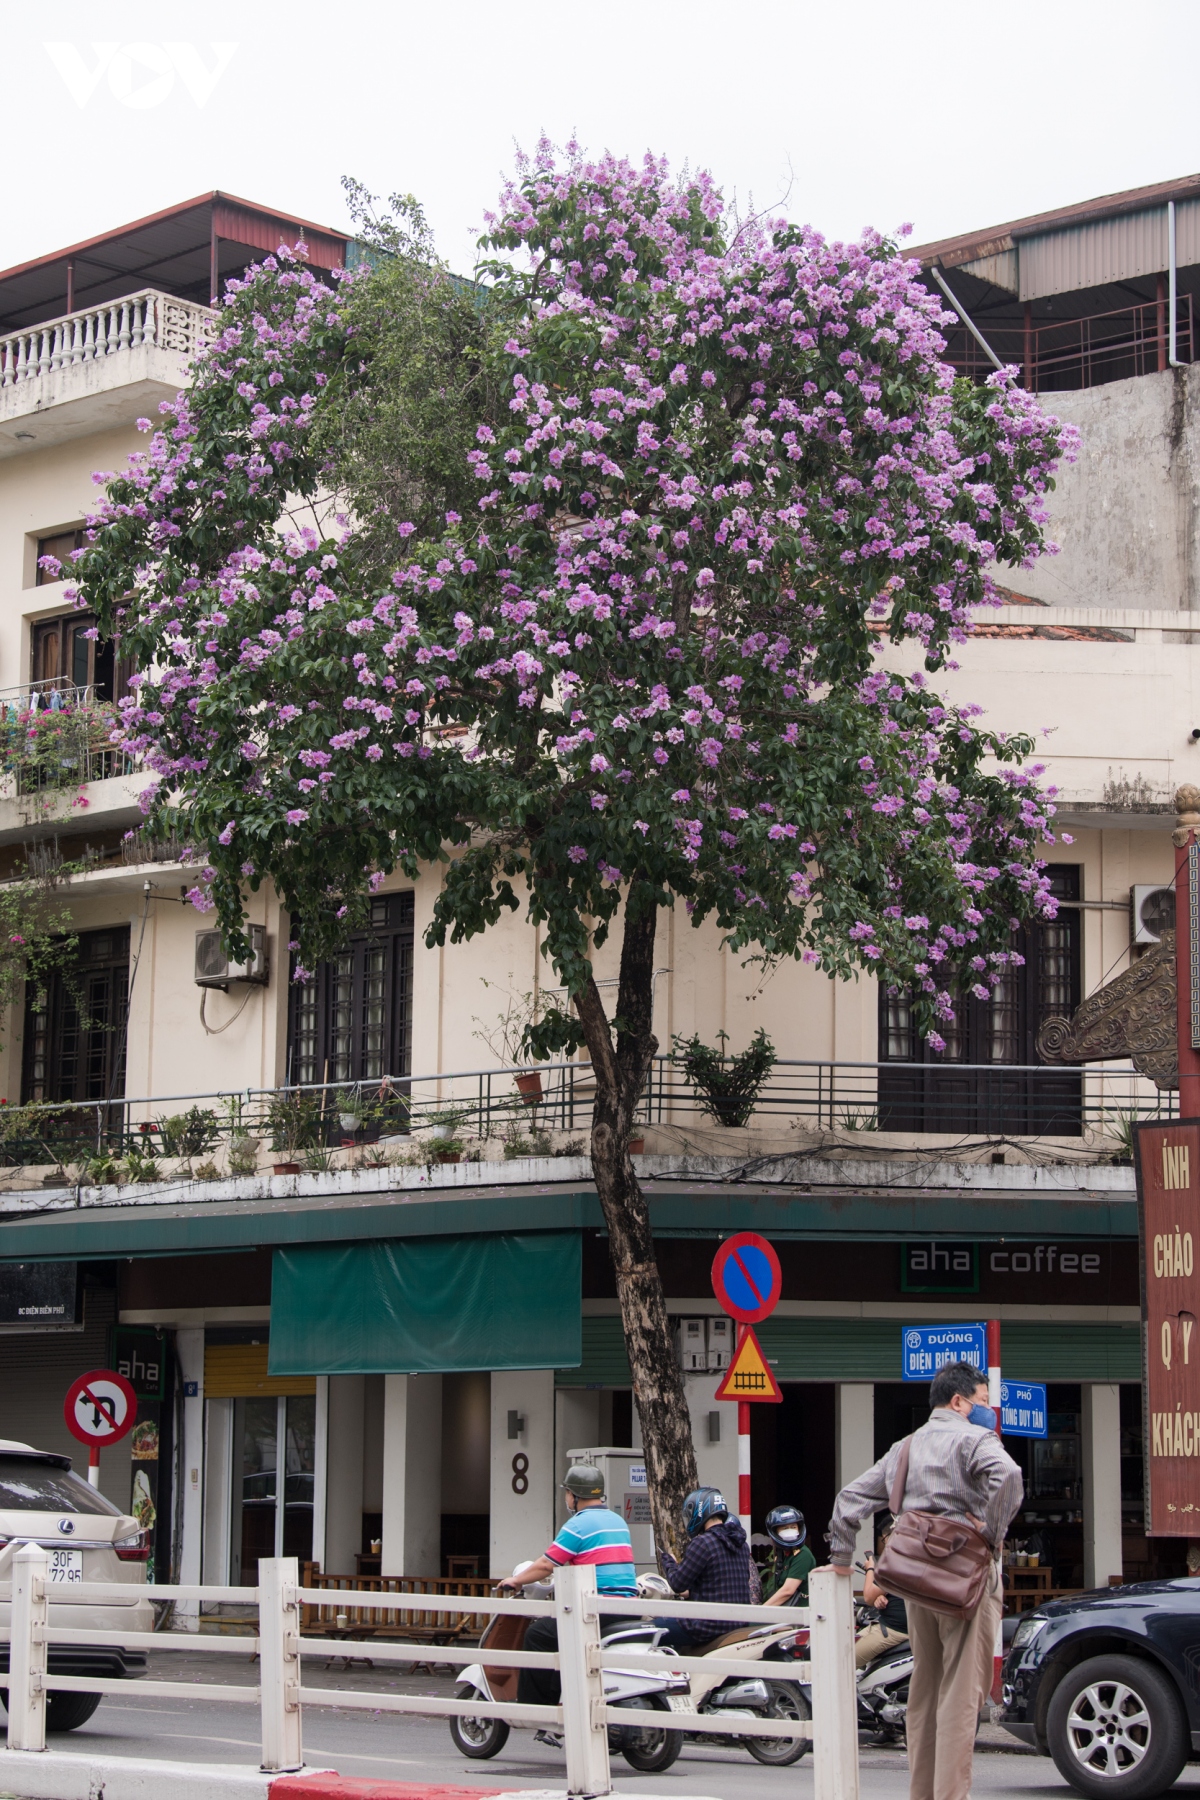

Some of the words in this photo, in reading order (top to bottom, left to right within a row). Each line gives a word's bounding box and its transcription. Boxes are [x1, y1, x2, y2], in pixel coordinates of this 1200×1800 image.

[910, 1241, 970, 1271] aha
[989, 1245, 1101, 1274] coffee
[1153, 1224, 1194, 1278] CHÀO
[928, 1331, 973, 1345] ĐƯỜNG
[118, 1349, 159, 1381] aha
[909, 1349, 932, 1374] ĐIỆN
[145, 1383, 158, 1391] Cafe
[1016, 1388, 1032, 1401] PHỐ
[1001, 1403, 1018, 1426] TỐNG
[1019, 1409, 1031, 1428] DUY
[1031, 1407, 1044, 1429] TÂN
[1152, 1402, 1200, 1457] KHÁCH
[511, 1452, 529, 1495] 8
[53, 1551, 73, 1567] 30F
